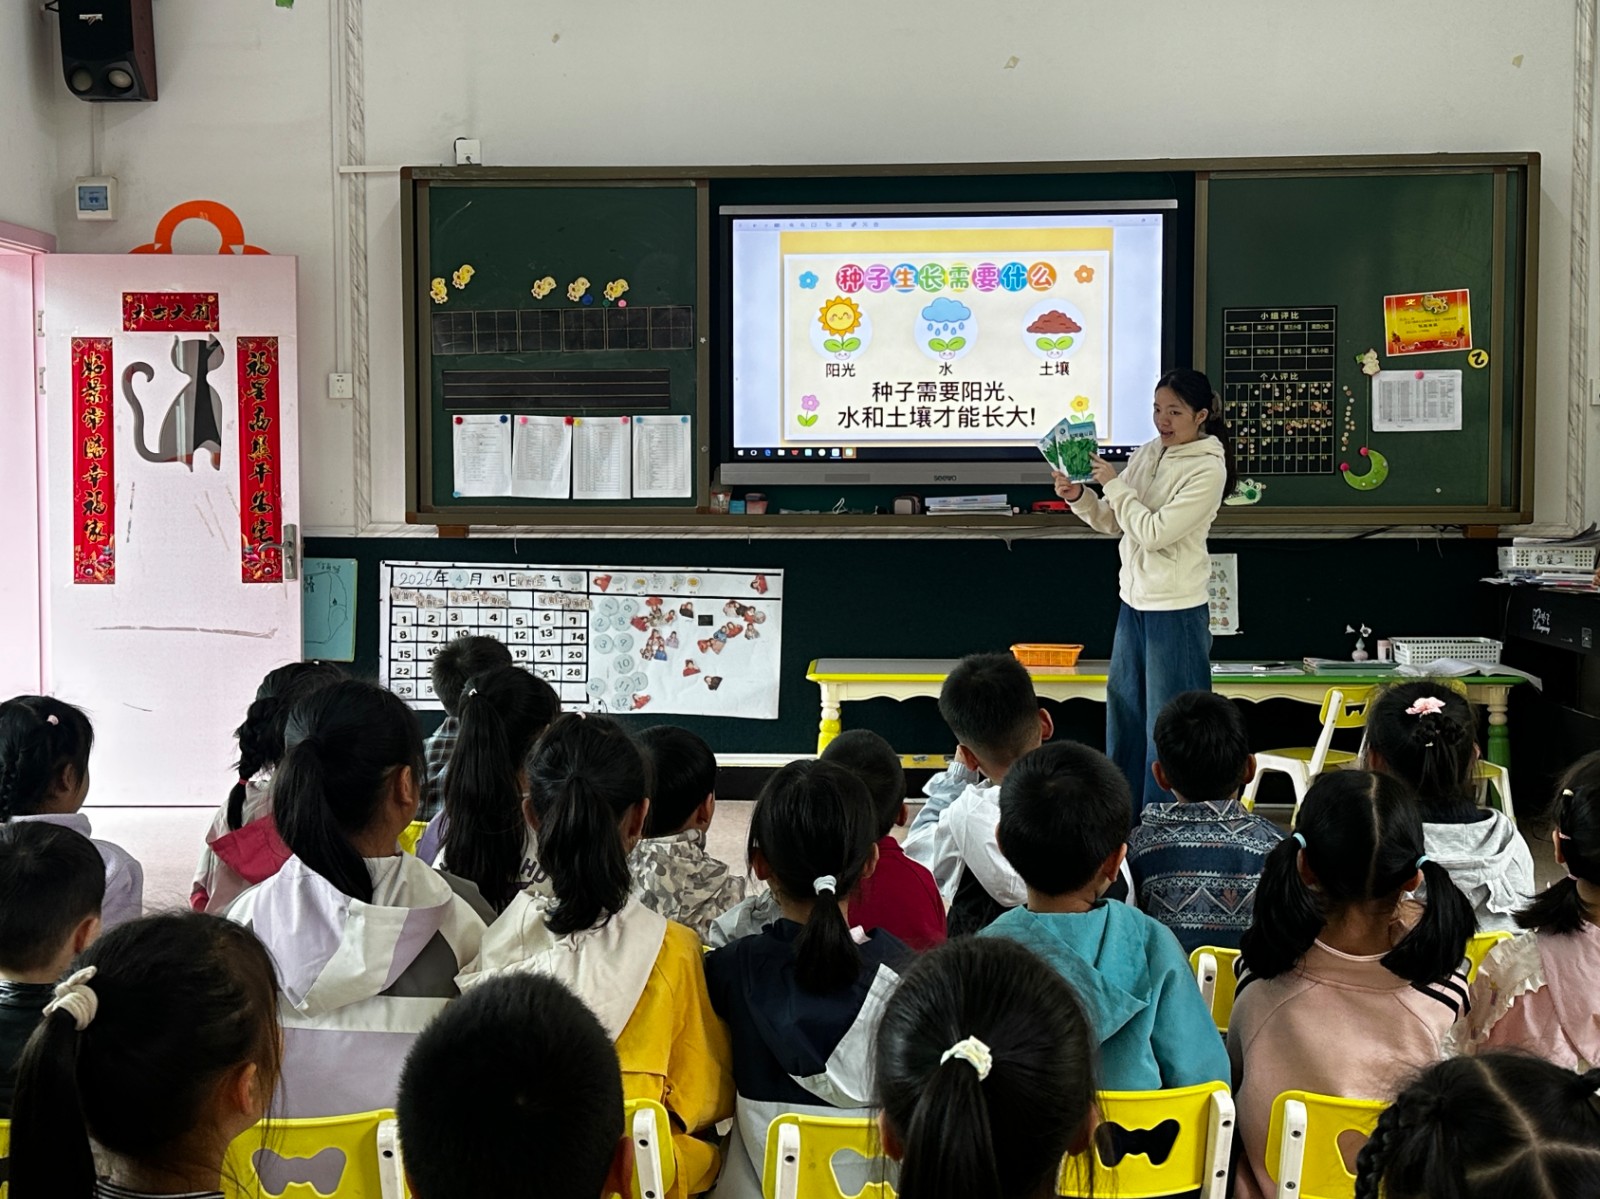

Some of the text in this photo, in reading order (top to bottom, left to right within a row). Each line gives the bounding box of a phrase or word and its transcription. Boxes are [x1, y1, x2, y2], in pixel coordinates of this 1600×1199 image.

[837, 264, 1054, 292] 种子生长需要什么
[131, 303, 210, 322] 大吉大利
[1260, 311, 1300, 320] 小组评比
[826, 361, 1070, 378] 阳光 水 土壤
[1260, 372, 1299, 381] 个人评比
[872, 381, 1016, 402] 种子需要阳光、
[400, 631, 407, 639] 8
[540, 629, 552, 638] 13
[399, 650, 411, 658] 15
[427, 646, 439, 656] 16
[540, 650, 552, 658] 21
[618, 660, 630, 669] 10
[543, 669, 555, 678] 27
[616, 698, 628, 707] 12
